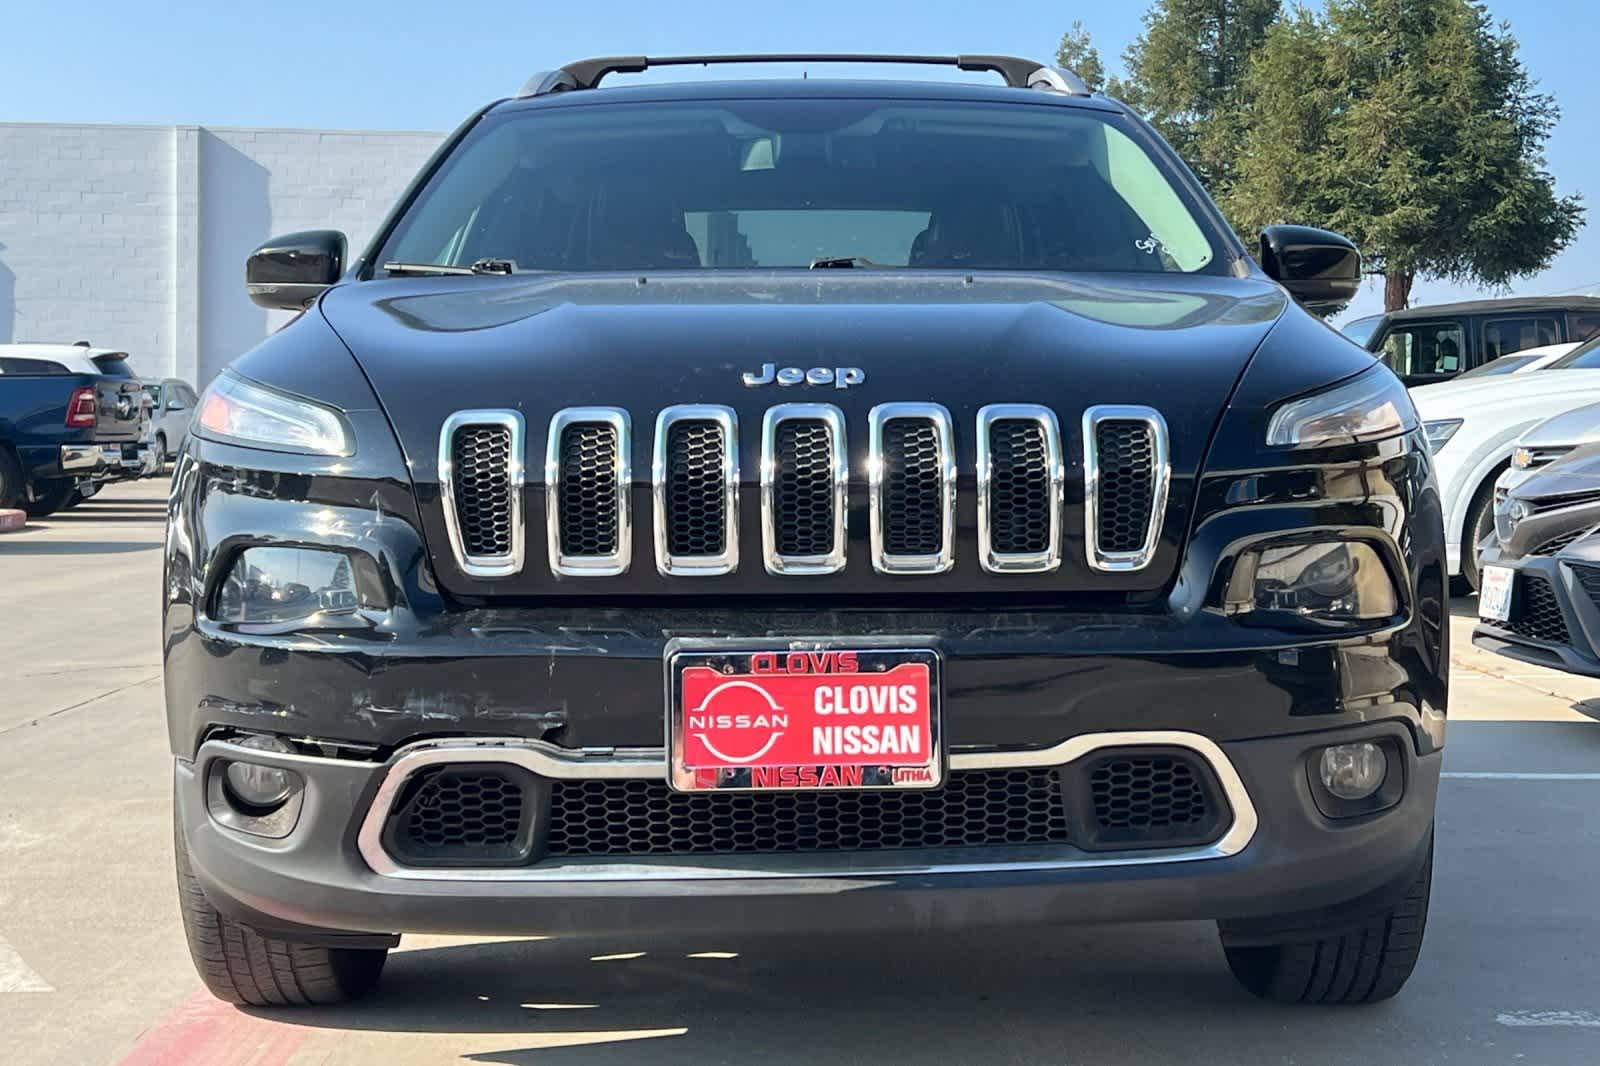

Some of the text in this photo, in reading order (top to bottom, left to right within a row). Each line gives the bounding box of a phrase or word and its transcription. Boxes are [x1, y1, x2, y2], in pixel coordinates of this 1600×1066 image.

[743, 363, 865, 388] Jeep
[751, 652, 859, 674] CLOVIS
[814, 685, 918, 715] CLOVIS
[689, 714, 788, 729] NISSAN
[812, 725, 920, 755] NISSAN
[752, 766, 863, 787] NISSAN
[892, 768, 932, 782] LITHIA
